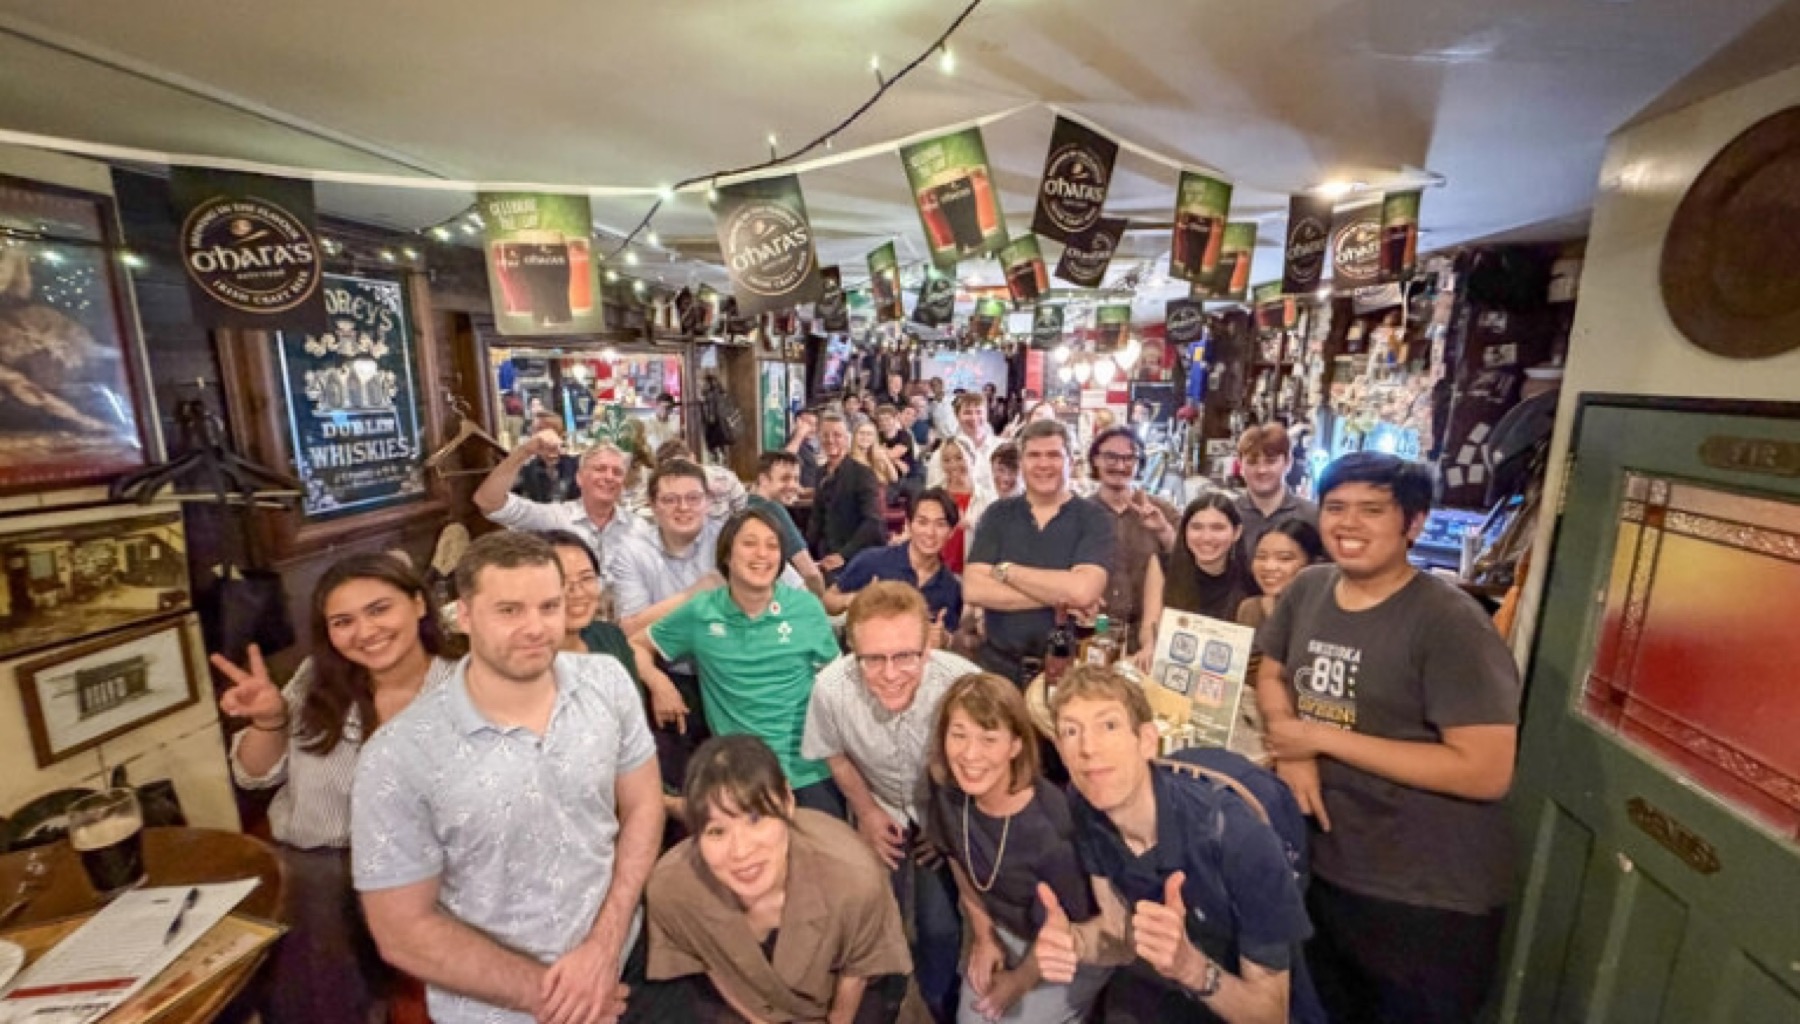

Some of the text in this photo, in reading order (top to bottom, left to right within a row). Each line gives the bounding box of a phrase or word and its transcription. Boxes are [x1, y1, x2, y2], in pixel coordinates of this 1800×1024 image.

[320, 417, 395, 439] DUBLIN
[307, 436, 408, 468] WHISKIES
[1311, 656, 1345, 697] 89
